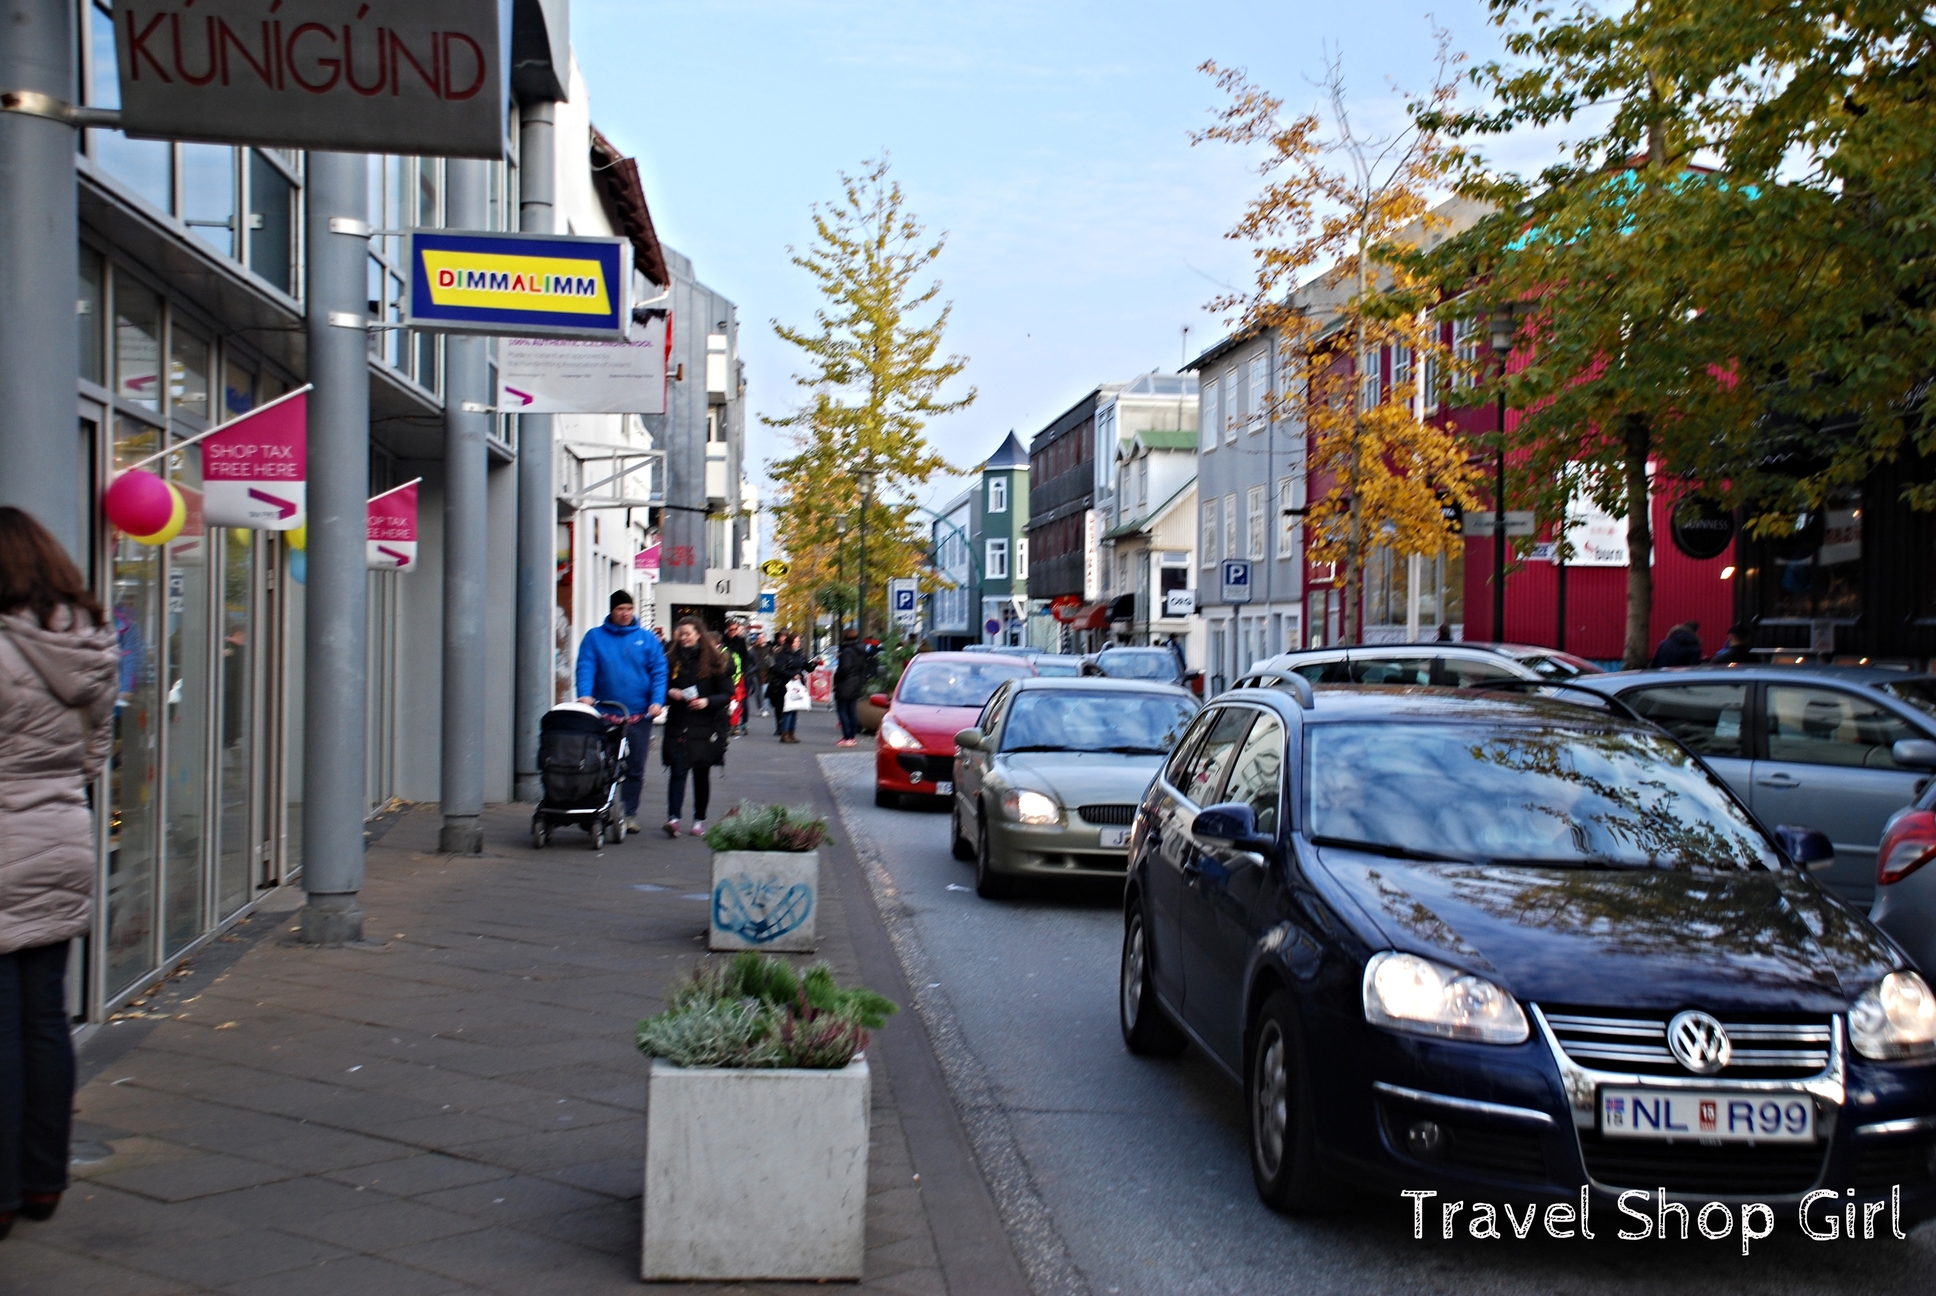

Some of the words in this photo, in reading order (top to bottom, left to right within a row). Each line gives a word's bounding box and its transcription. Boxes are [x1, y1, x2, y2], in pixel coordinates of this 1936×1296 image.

[126, 0, 486, 100] KÚNÍGÚND
[438, 269, 596, 296] DIMMALIMM
[209, 444, 258, 459] SHOP
[260, 445, 294, 459] TAX
[209, 462, 252, 477] FREE
[253, 463, 299, 478] HERE
[386, 516, 408, 527] TAX
[381, 528, 411, 539] HERE
[715, 578, 730, 595] 61
[1631, 1096, 1689, 1132] NL
[1728, 1100, 1807, 1134] R99
